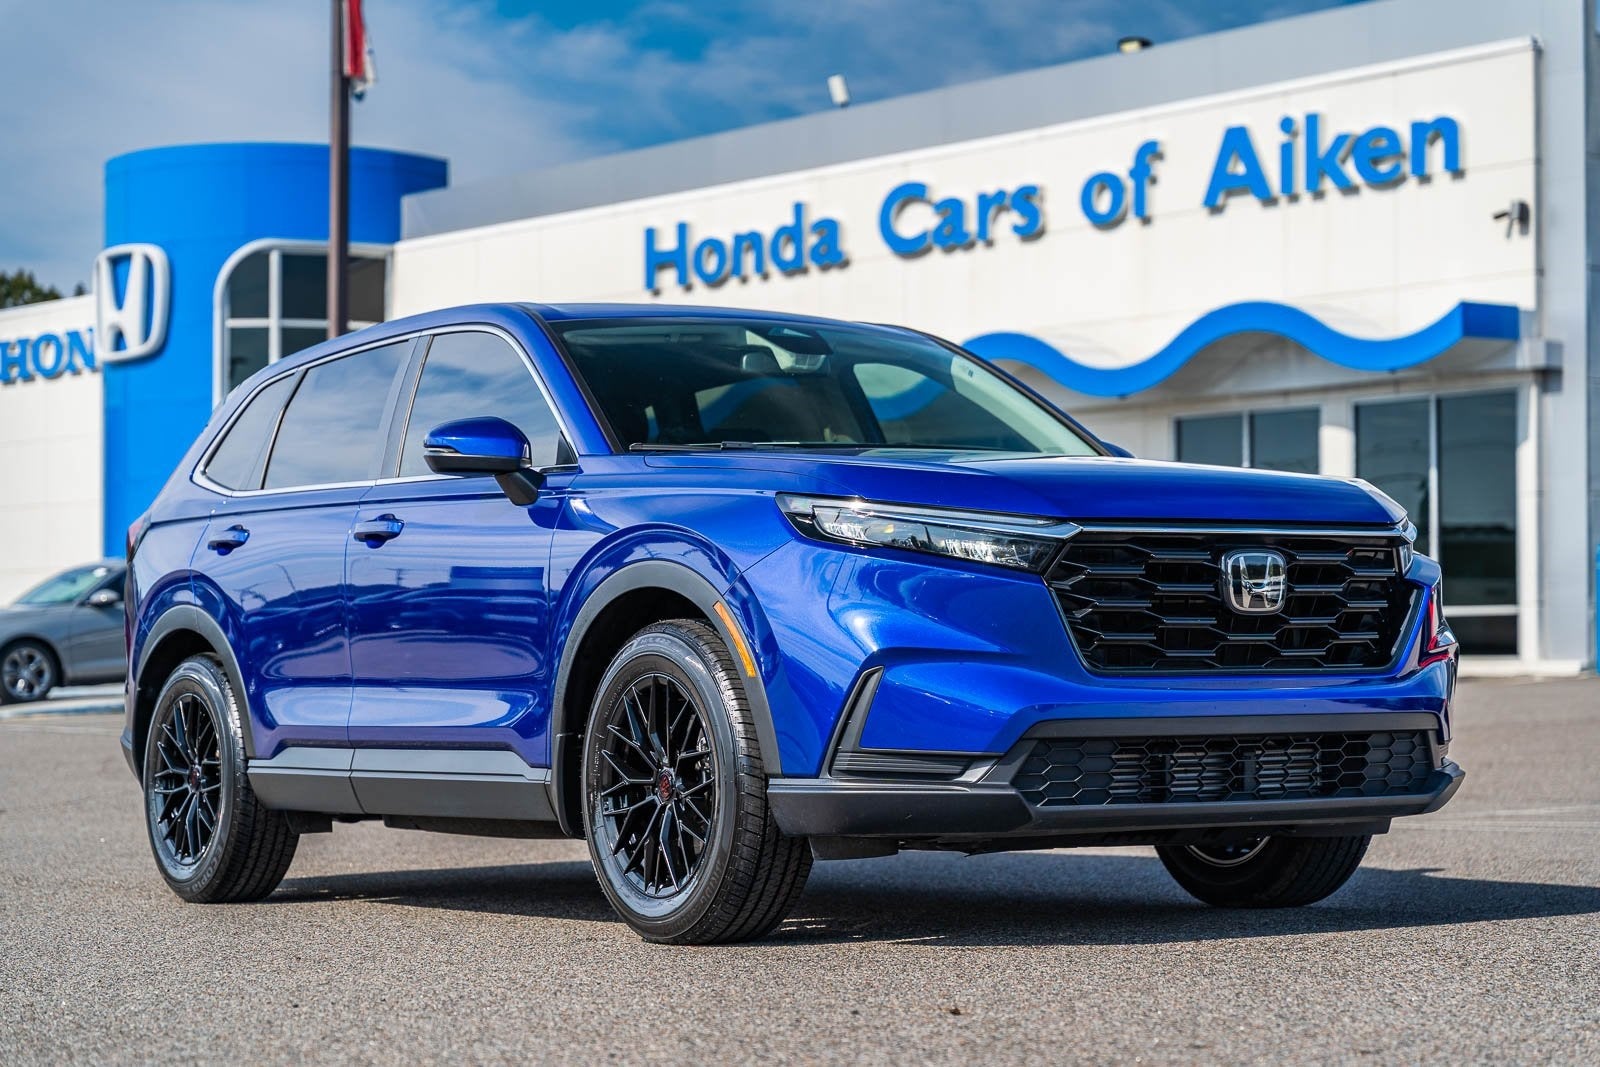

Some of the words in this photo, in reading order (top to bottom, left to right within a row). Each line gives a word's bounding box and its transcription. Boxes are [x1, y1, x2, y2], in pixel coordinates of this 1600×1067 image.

[644, 202, 845, 292] Honda
[879, 181, 1043, 256] Cars
[1080, 139, 1161, 226] of
[1202, 112, 1462, 211] Aiken
